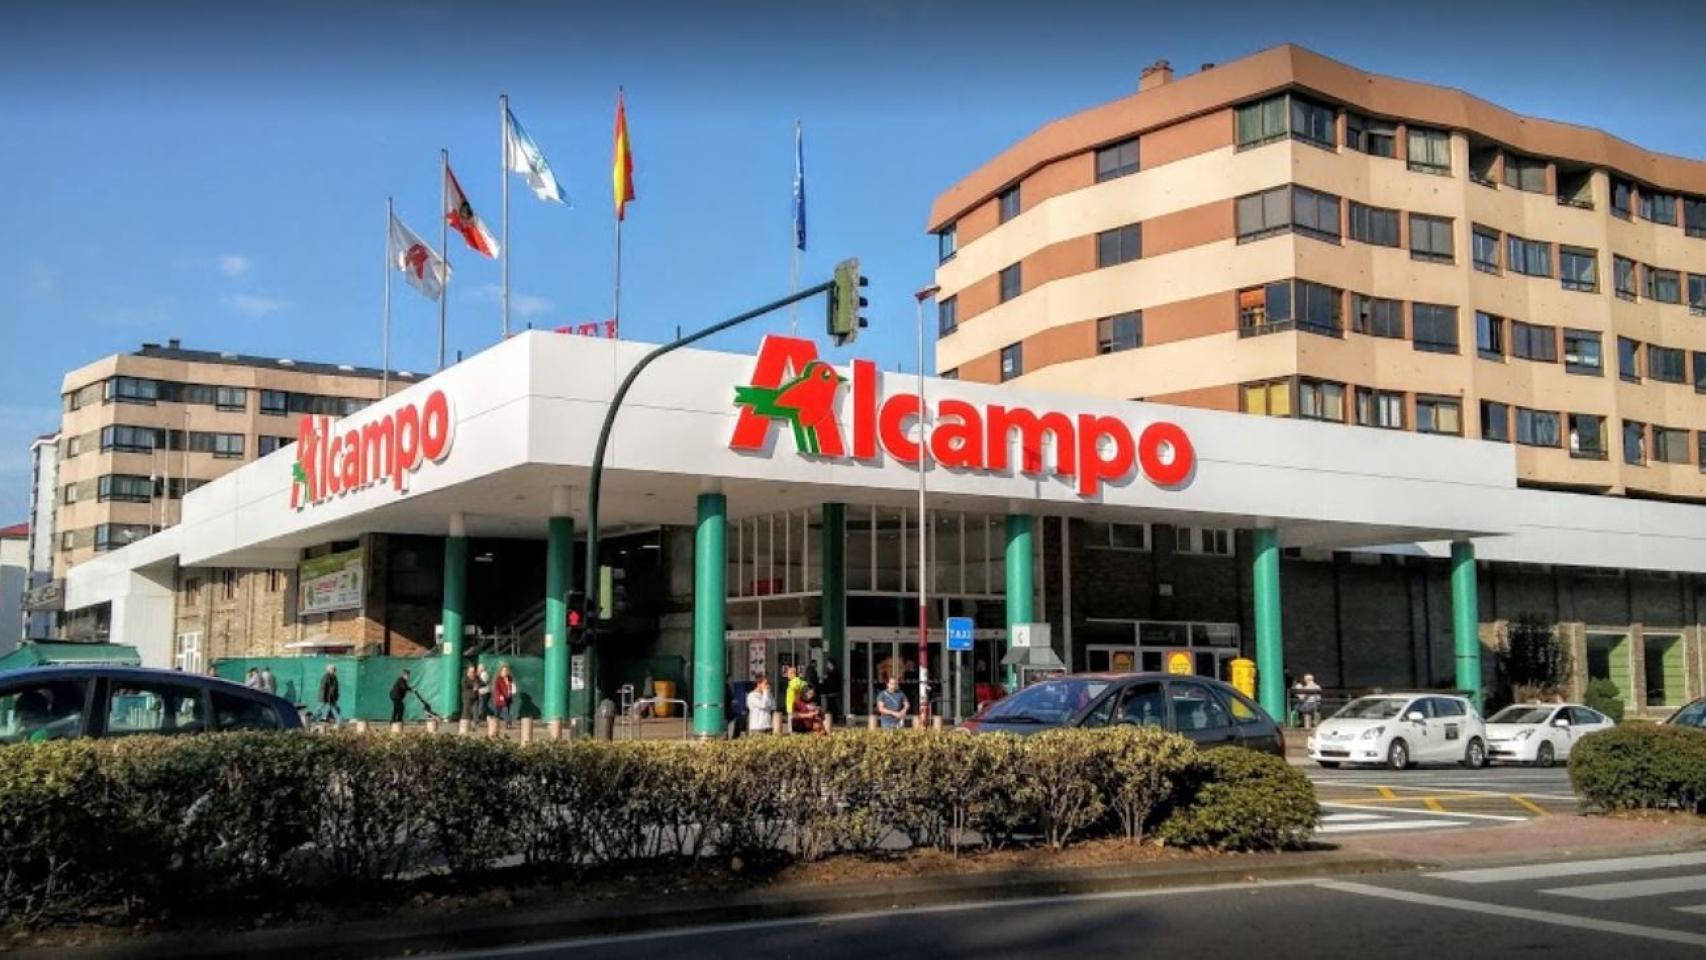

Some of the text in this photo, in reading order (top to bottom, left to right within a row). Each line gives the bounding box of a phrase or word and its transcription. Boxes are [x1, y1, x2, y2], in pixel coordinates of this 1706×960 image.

[290, 390, 448, 509] Alcampo
[728, 334, 1195, 497] Alcampo
[949, 629, 971, 640] TAXI
